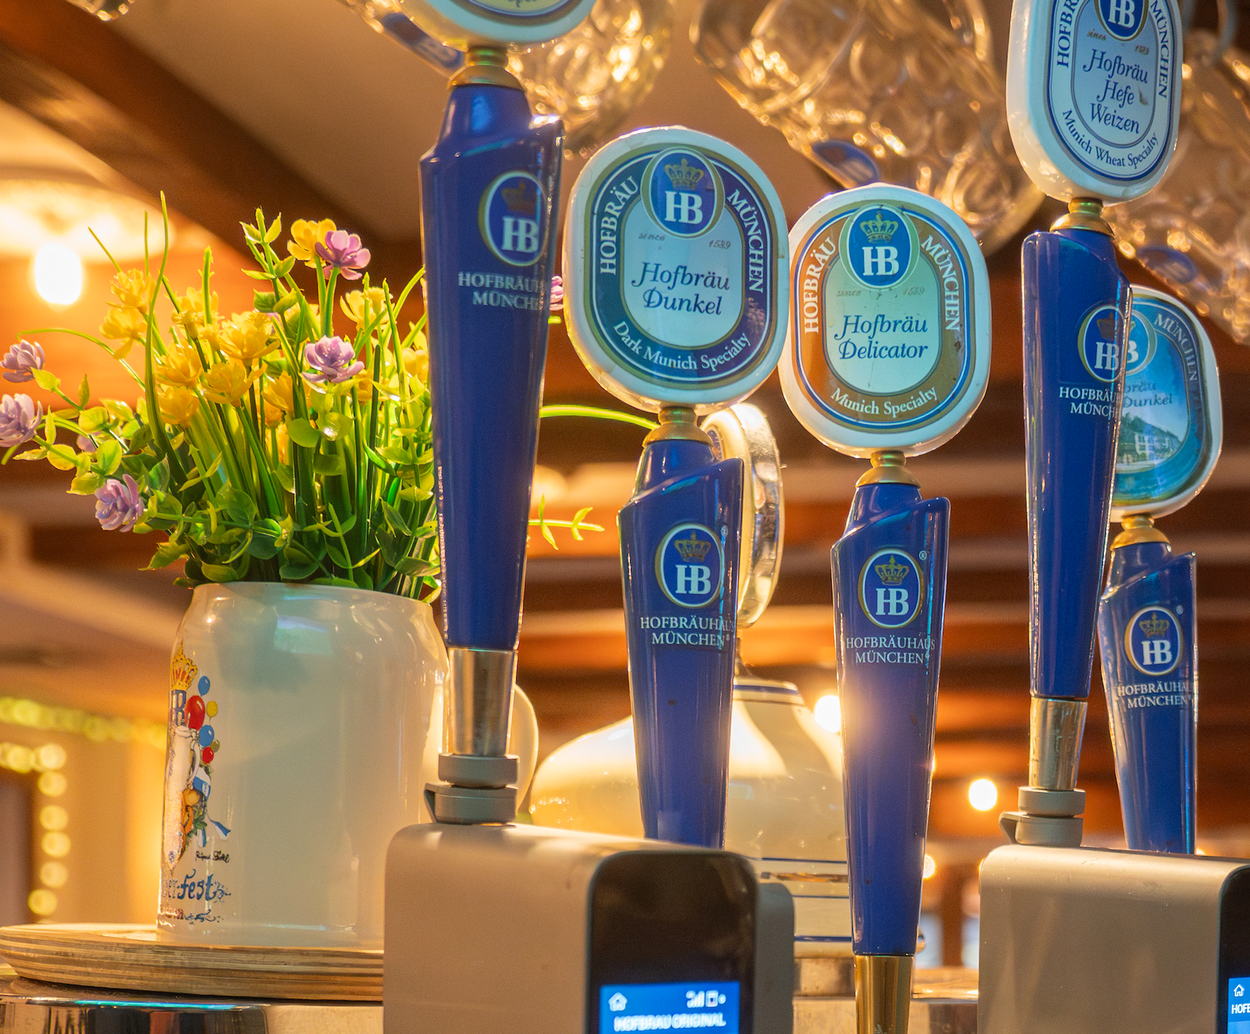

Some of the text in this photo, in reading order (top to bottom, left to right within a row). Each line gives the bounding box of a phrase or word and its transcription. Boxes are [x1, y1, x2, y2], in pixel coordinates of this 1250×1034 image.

[1108, 0, 1135, 29] HB
[1057, 0, 1170, 98] HOFBR MÜNCHEN
[1082, 48, 1148, 84] Hofbräu
[1096, 79, 1135, 109] Hefe
[1090, 102, 1140, 135] Weizen
[1062, 109, 1159, 170] Munich Wheat Specialty
[664, 190, 703, 225] HB
[502, 217, 539, 253] HB
[600, 176, 763, 293] HOFBRÄU MÜNCHEN
[631, 262, 730, 290] Hofbräu
[862, 246, 900, 276] HB
[458, 271, 543, 293] HOFBRÄU
[803, 235, 961, 335] HOFBRÄU MÜNCHEN
[642, 287, 722, 316] Dunkel
[834, 314, 928, 340] Hofbräu
[613, 321, 751, 371] Dark Munich Specialty
[838, 337, 929, 360] Delicator
[1094, 341, 1119, 371] HB
[1125, 340, 1139, 363] B
[1154, 313, 1198, 382] MÜNCHEN
[830, 386, 938, 418] Munich Specialty
[1059, 386, 1117, 403] HOFBRÄU
[1070, 401, 1116, 417] MÜNCH
[675, 564, 712, 595] HB
[875, 587, 909, 616] HB
[846, 634, 936, 650] HOFBRÄUHAUS
[1141, 640, 1172, 666] HB
[672, 1012, 727, 1029] ORIGINAL
